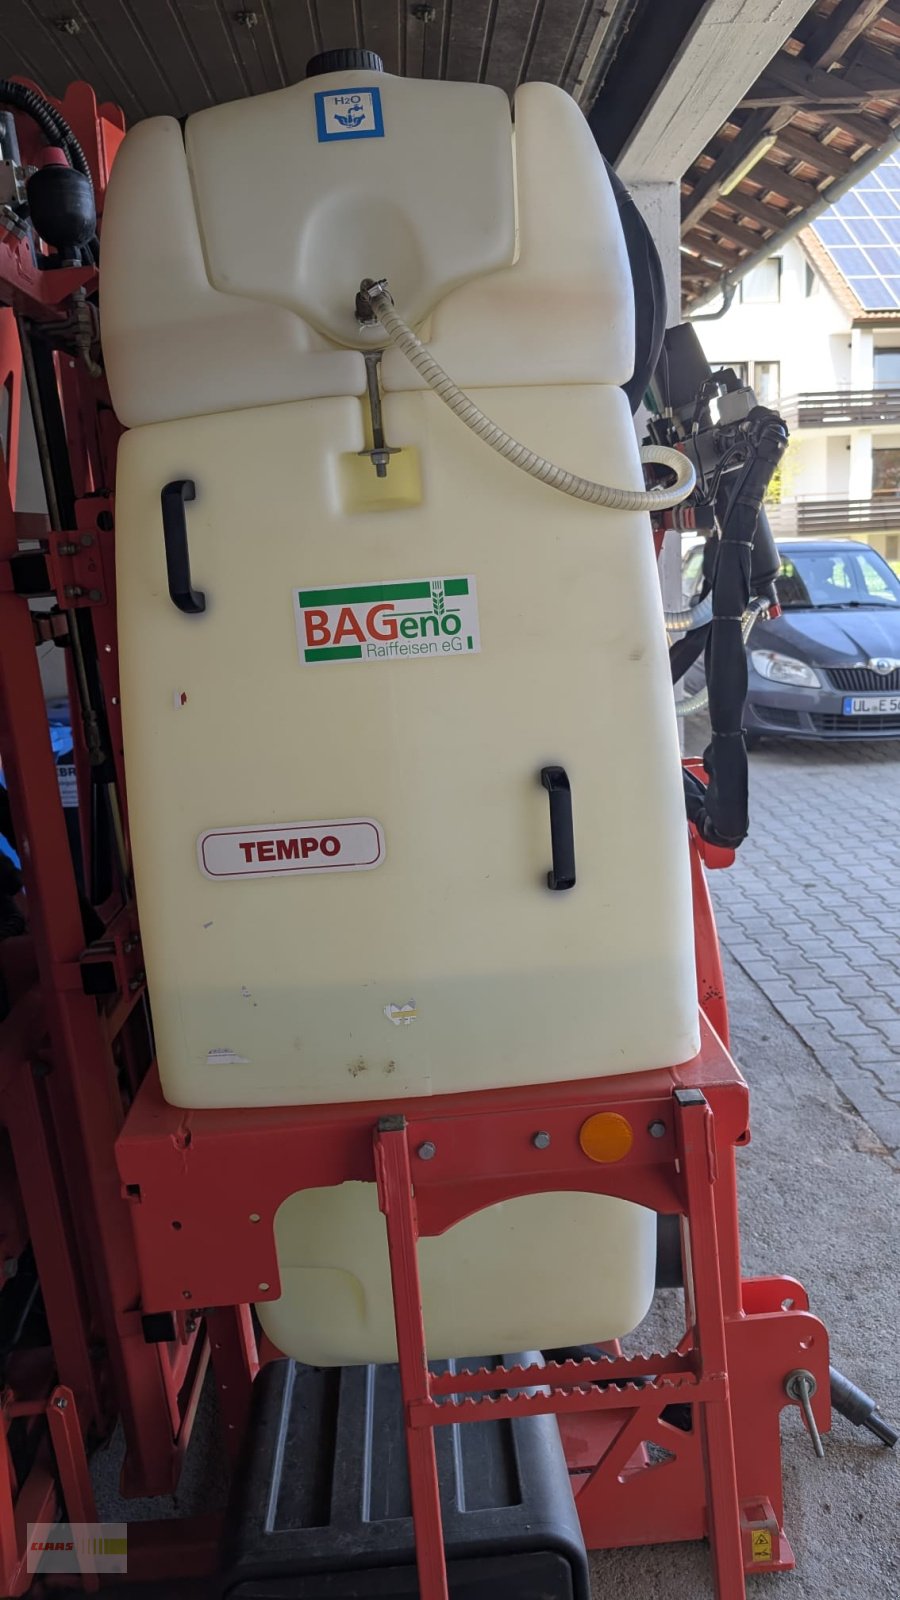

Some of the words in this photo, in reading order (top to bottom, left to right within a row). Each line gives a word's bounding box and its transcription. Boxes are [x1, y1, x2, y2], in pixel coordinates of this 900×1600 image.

[334, 95, 361, 105] H2O
[304, 603, 462, 647] BAGeno
[366, 642, 438, 658] Raiffeisen
[441, 636, 463, 652] eG
[239, 835, 341, 863] TEMPO
